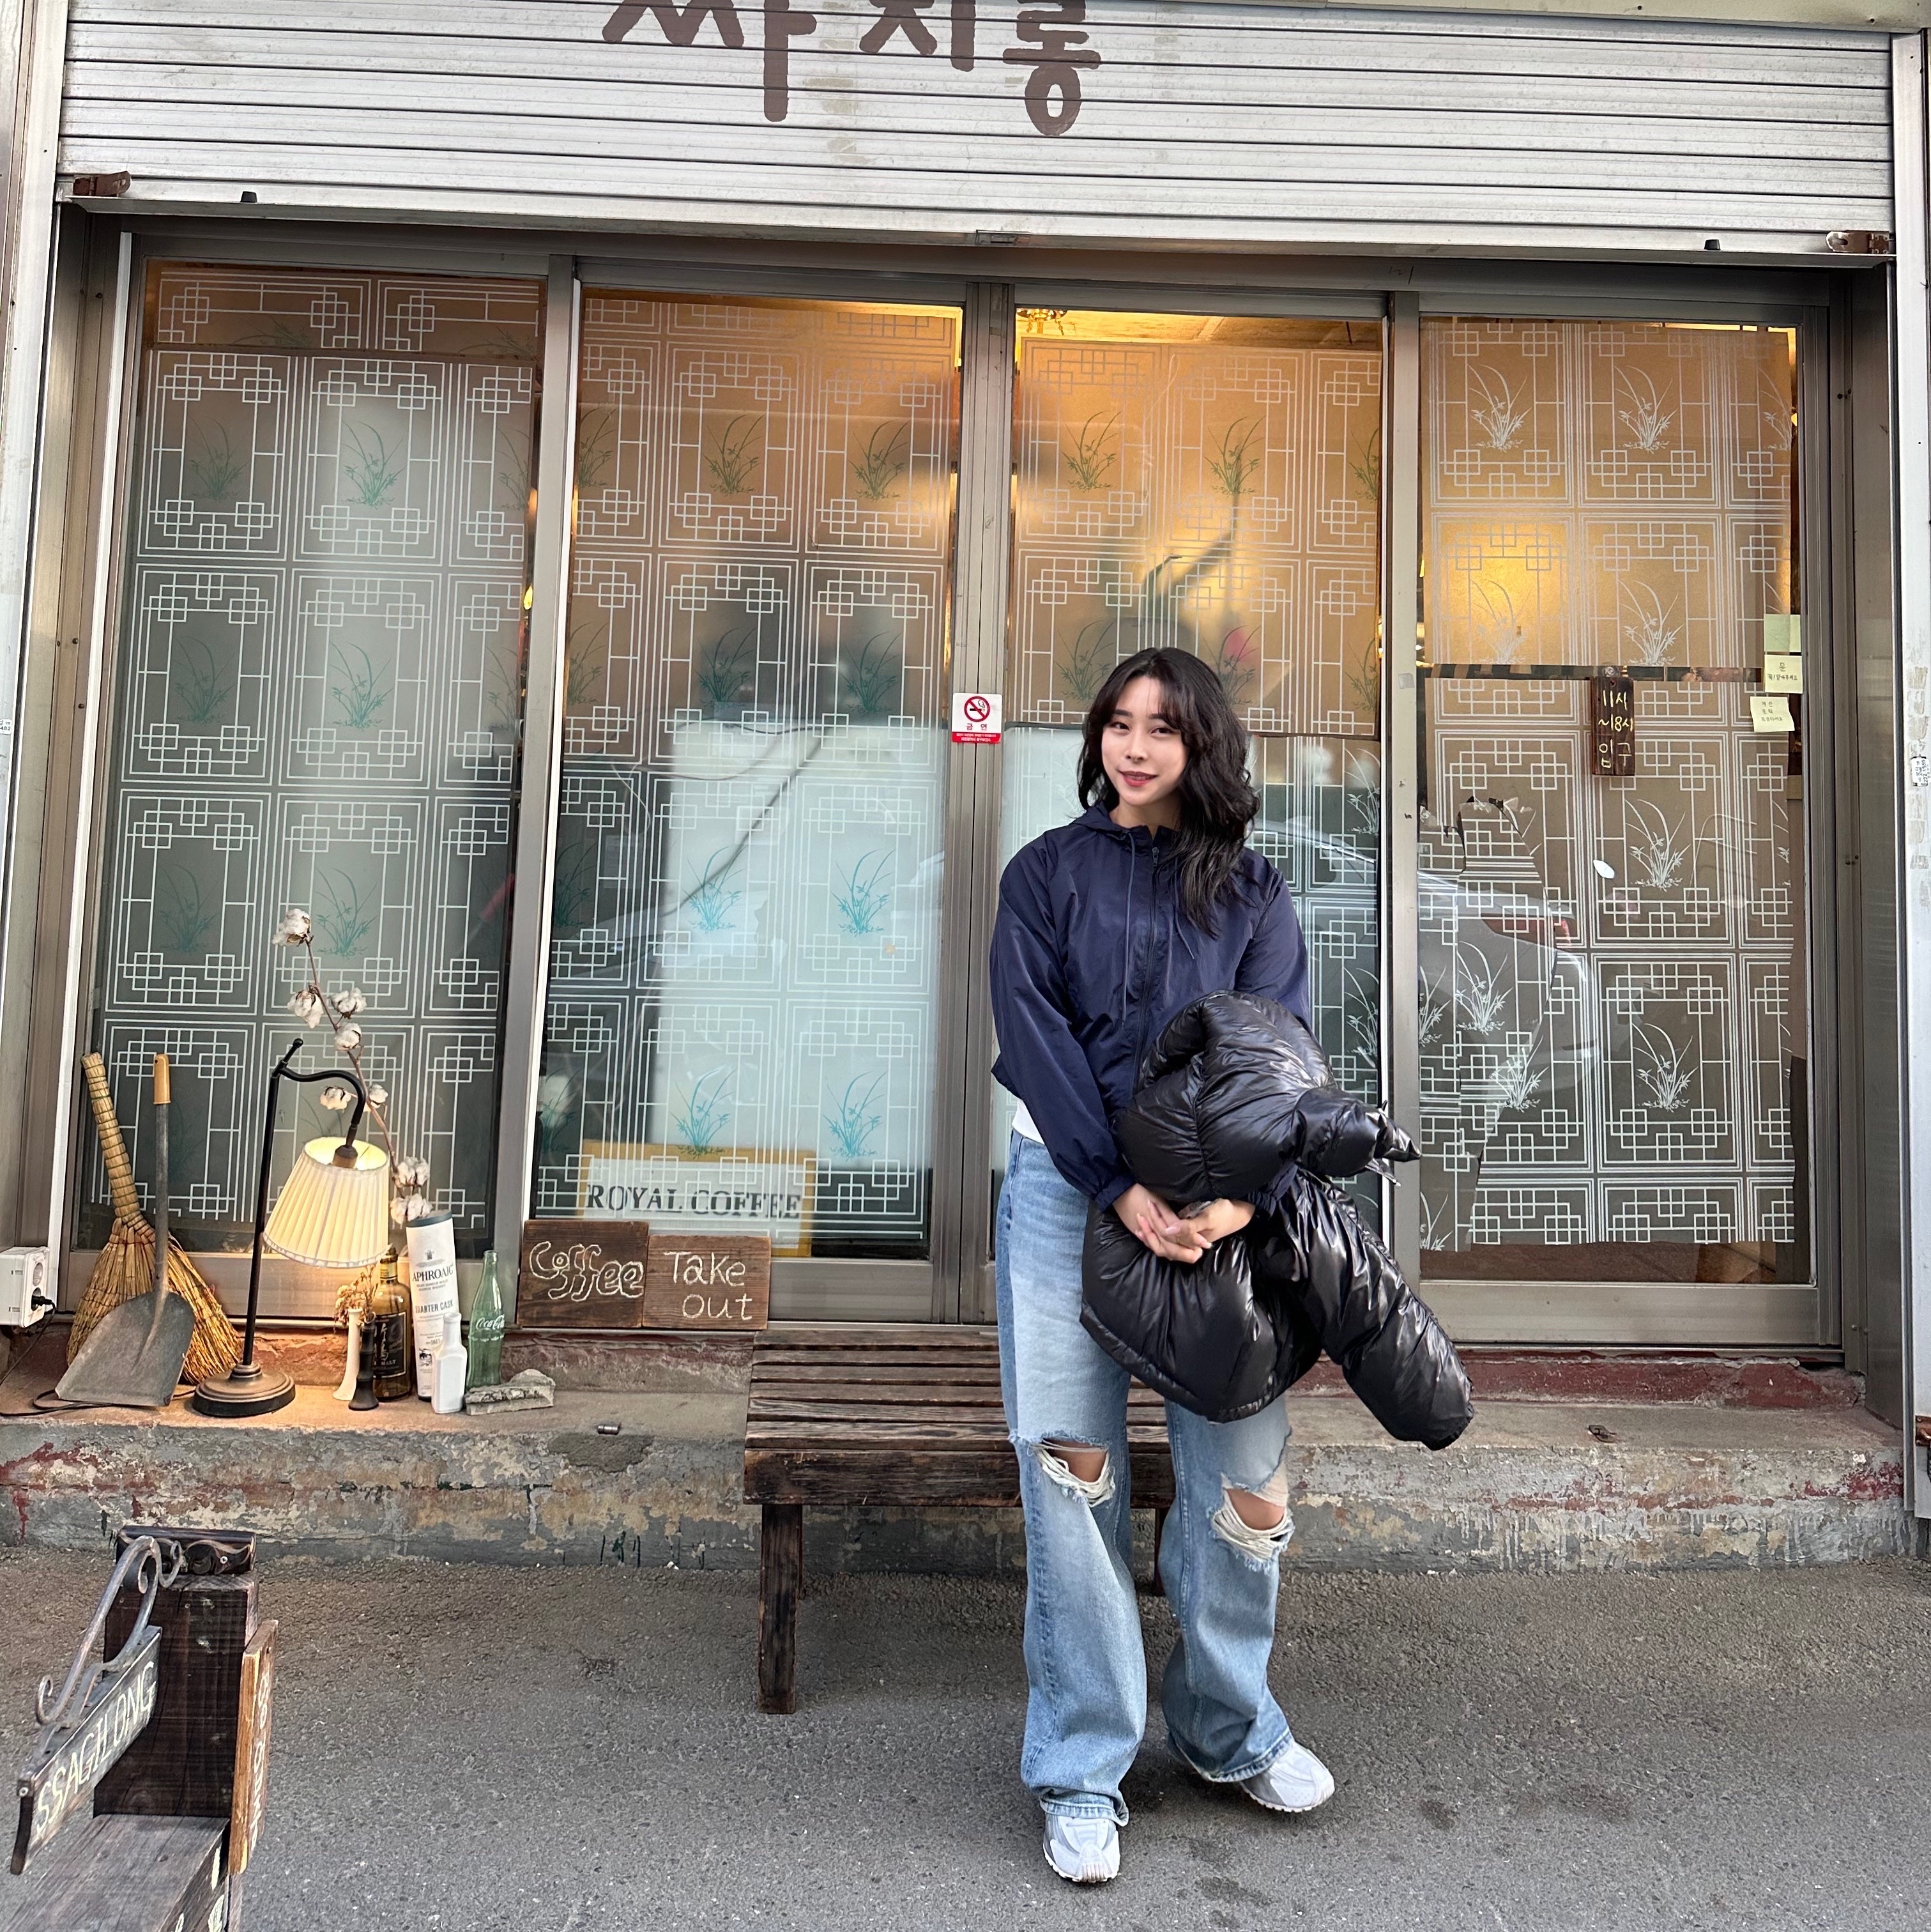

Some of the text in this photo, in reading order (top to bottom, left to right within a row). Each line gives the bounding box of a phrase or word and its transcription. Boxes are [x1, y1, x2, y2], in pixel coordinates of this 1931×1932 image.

[1779, 663, 1786, 671] 문
[1603, 689, 1628, 710] 11시
[1599, 739, 1633, 769] 입구
[586, 1184, 802, 1219] ROYAL COFFEE
[530, 1241, 643, 1302] Coffee
[663, 1250, 747, 1287] Take
[440, 1300, 454, 1310] CASK
[35, 1661, 157, 1833] SSAGILONG
